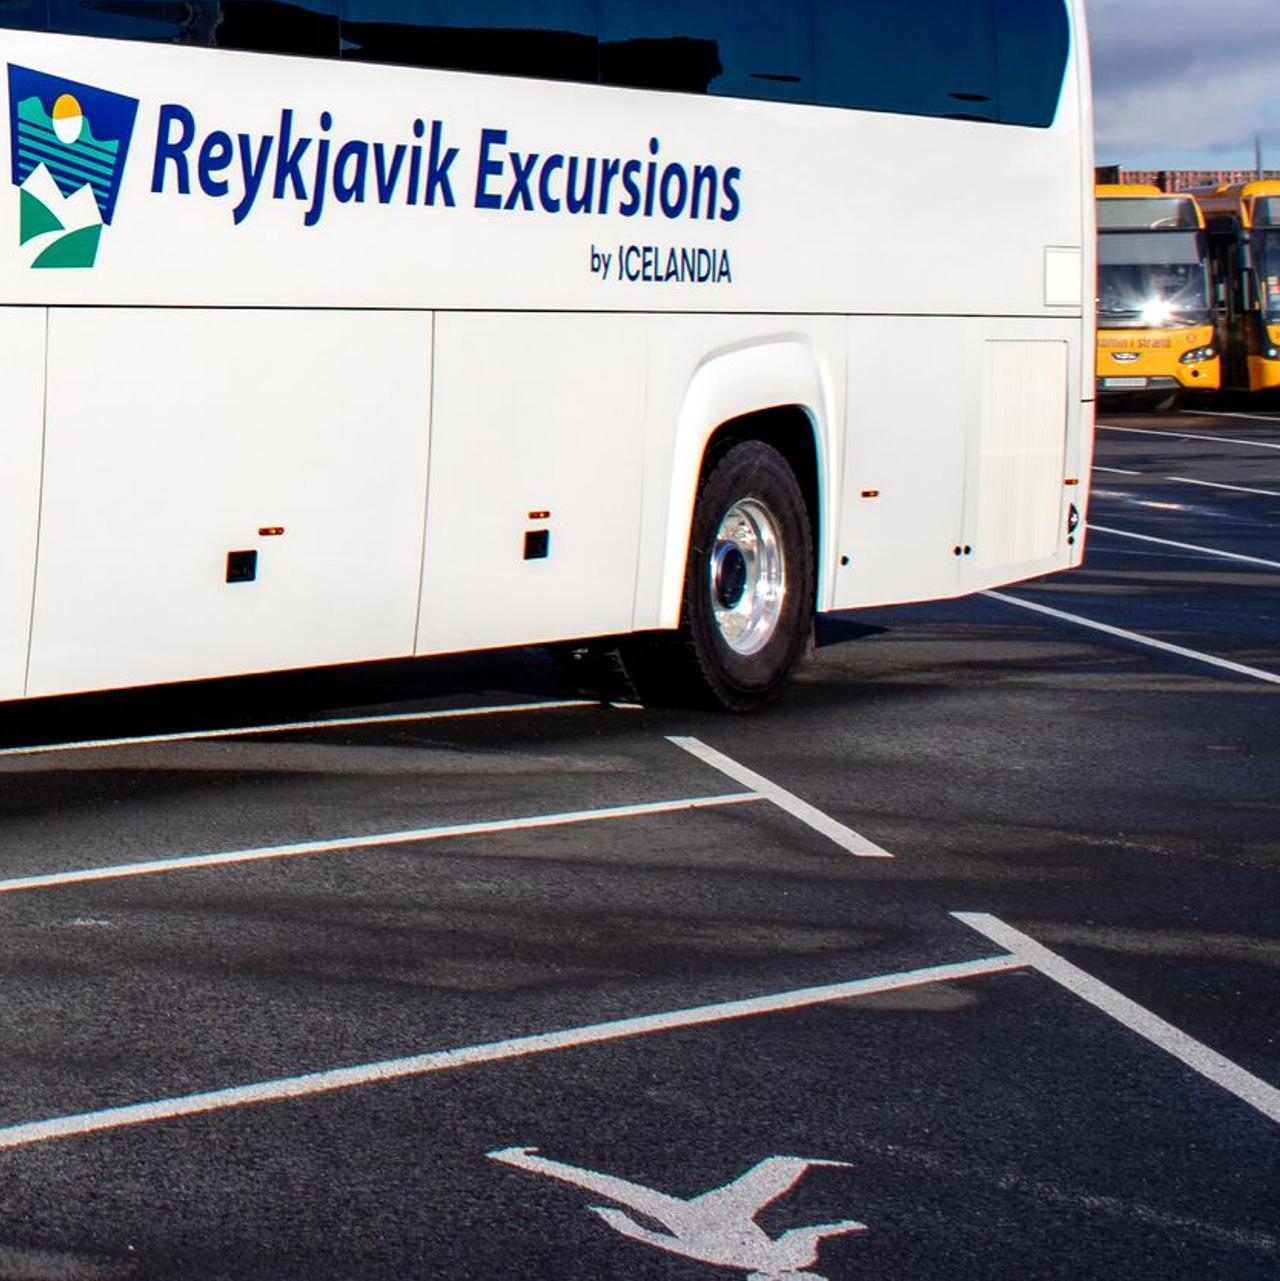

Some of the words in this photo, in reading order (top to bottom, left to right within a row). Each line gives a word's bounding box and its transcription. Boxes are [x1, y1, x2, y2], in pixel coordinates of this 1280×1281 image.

[150, 103, 460, 227] Reykjavik
[473, 127, 742, 223] Excursions
[590, 245, 611, 280] by
[618, 245, 732, 283] ICELANDIA
